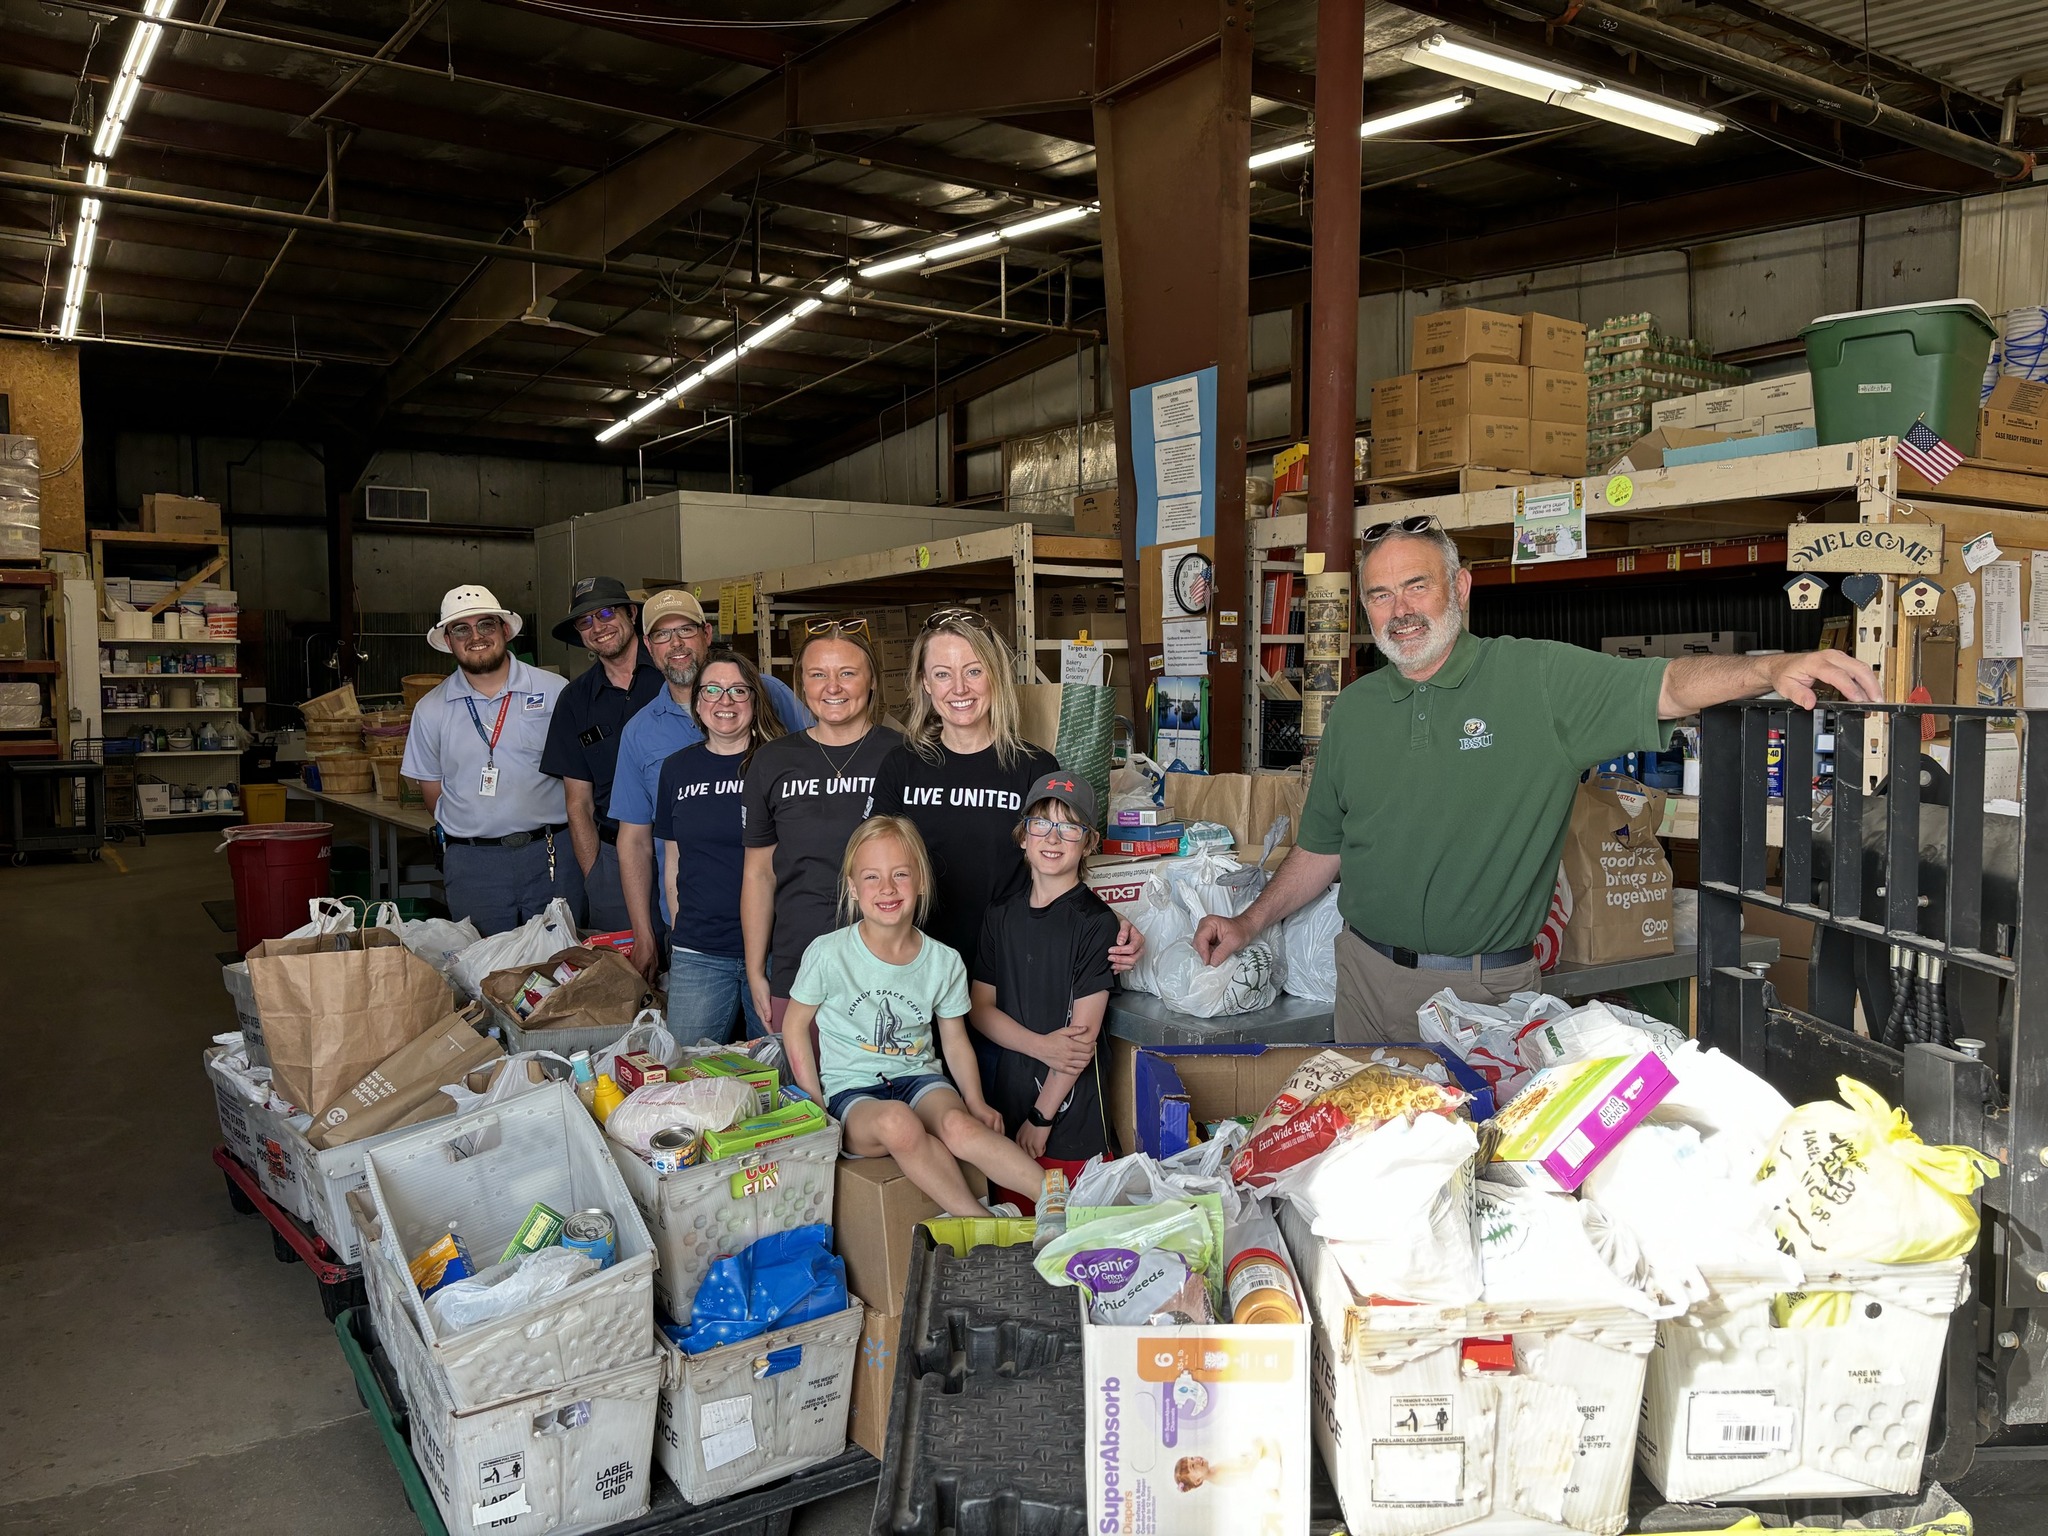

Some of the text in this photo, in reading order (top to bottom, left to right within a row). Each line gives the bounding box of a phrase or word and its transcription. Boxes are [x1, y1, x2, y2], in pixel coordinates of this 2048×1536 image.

[1792, 530, 1934, 565] WELCOME
[1459, 734, 1493, 750] BSU
[677, 782, 710, 800] LIVE
[782, 779, 820, 798] LIVE
[903, 786, 1021, 810] LIVE UNITED
[317, 846, 331, 858] ACE
[1601, 841, 1623, 852] we
[1600, 854, 1635, 871] good
[1606, 871, 1647, 889] brings
[1606, 888, 1667, 910] together
[876, 990, 905, 1001] SPACE
[365, 1076, 379, 1089] are
[372, 1070, 385, 1082] our
[359, 1082, 380, 1102] open
[1603, 1102, 1629, 1126] Raisin
[1258, 1117, 1312, 1152] Extra Wide Egg
[1127, 1268, 1165, 1299] seeds
[1154, 1352, 1174, 1368] 6
[820, 1373, 840, 1383] WEIGHT
[421, 1422, 445, 1473] STATES
[1100, 1377, 1124, 1534] SuperAbsorb
[422, 1446, 450, 1504] SERVICE
[597, 1460, 633, 1481] LABEL
[595, 1470, 633, 1492] OTHER
[602, 1484, 626, 1500] END
[1123, 1491, 1133, 1535] Diapers
